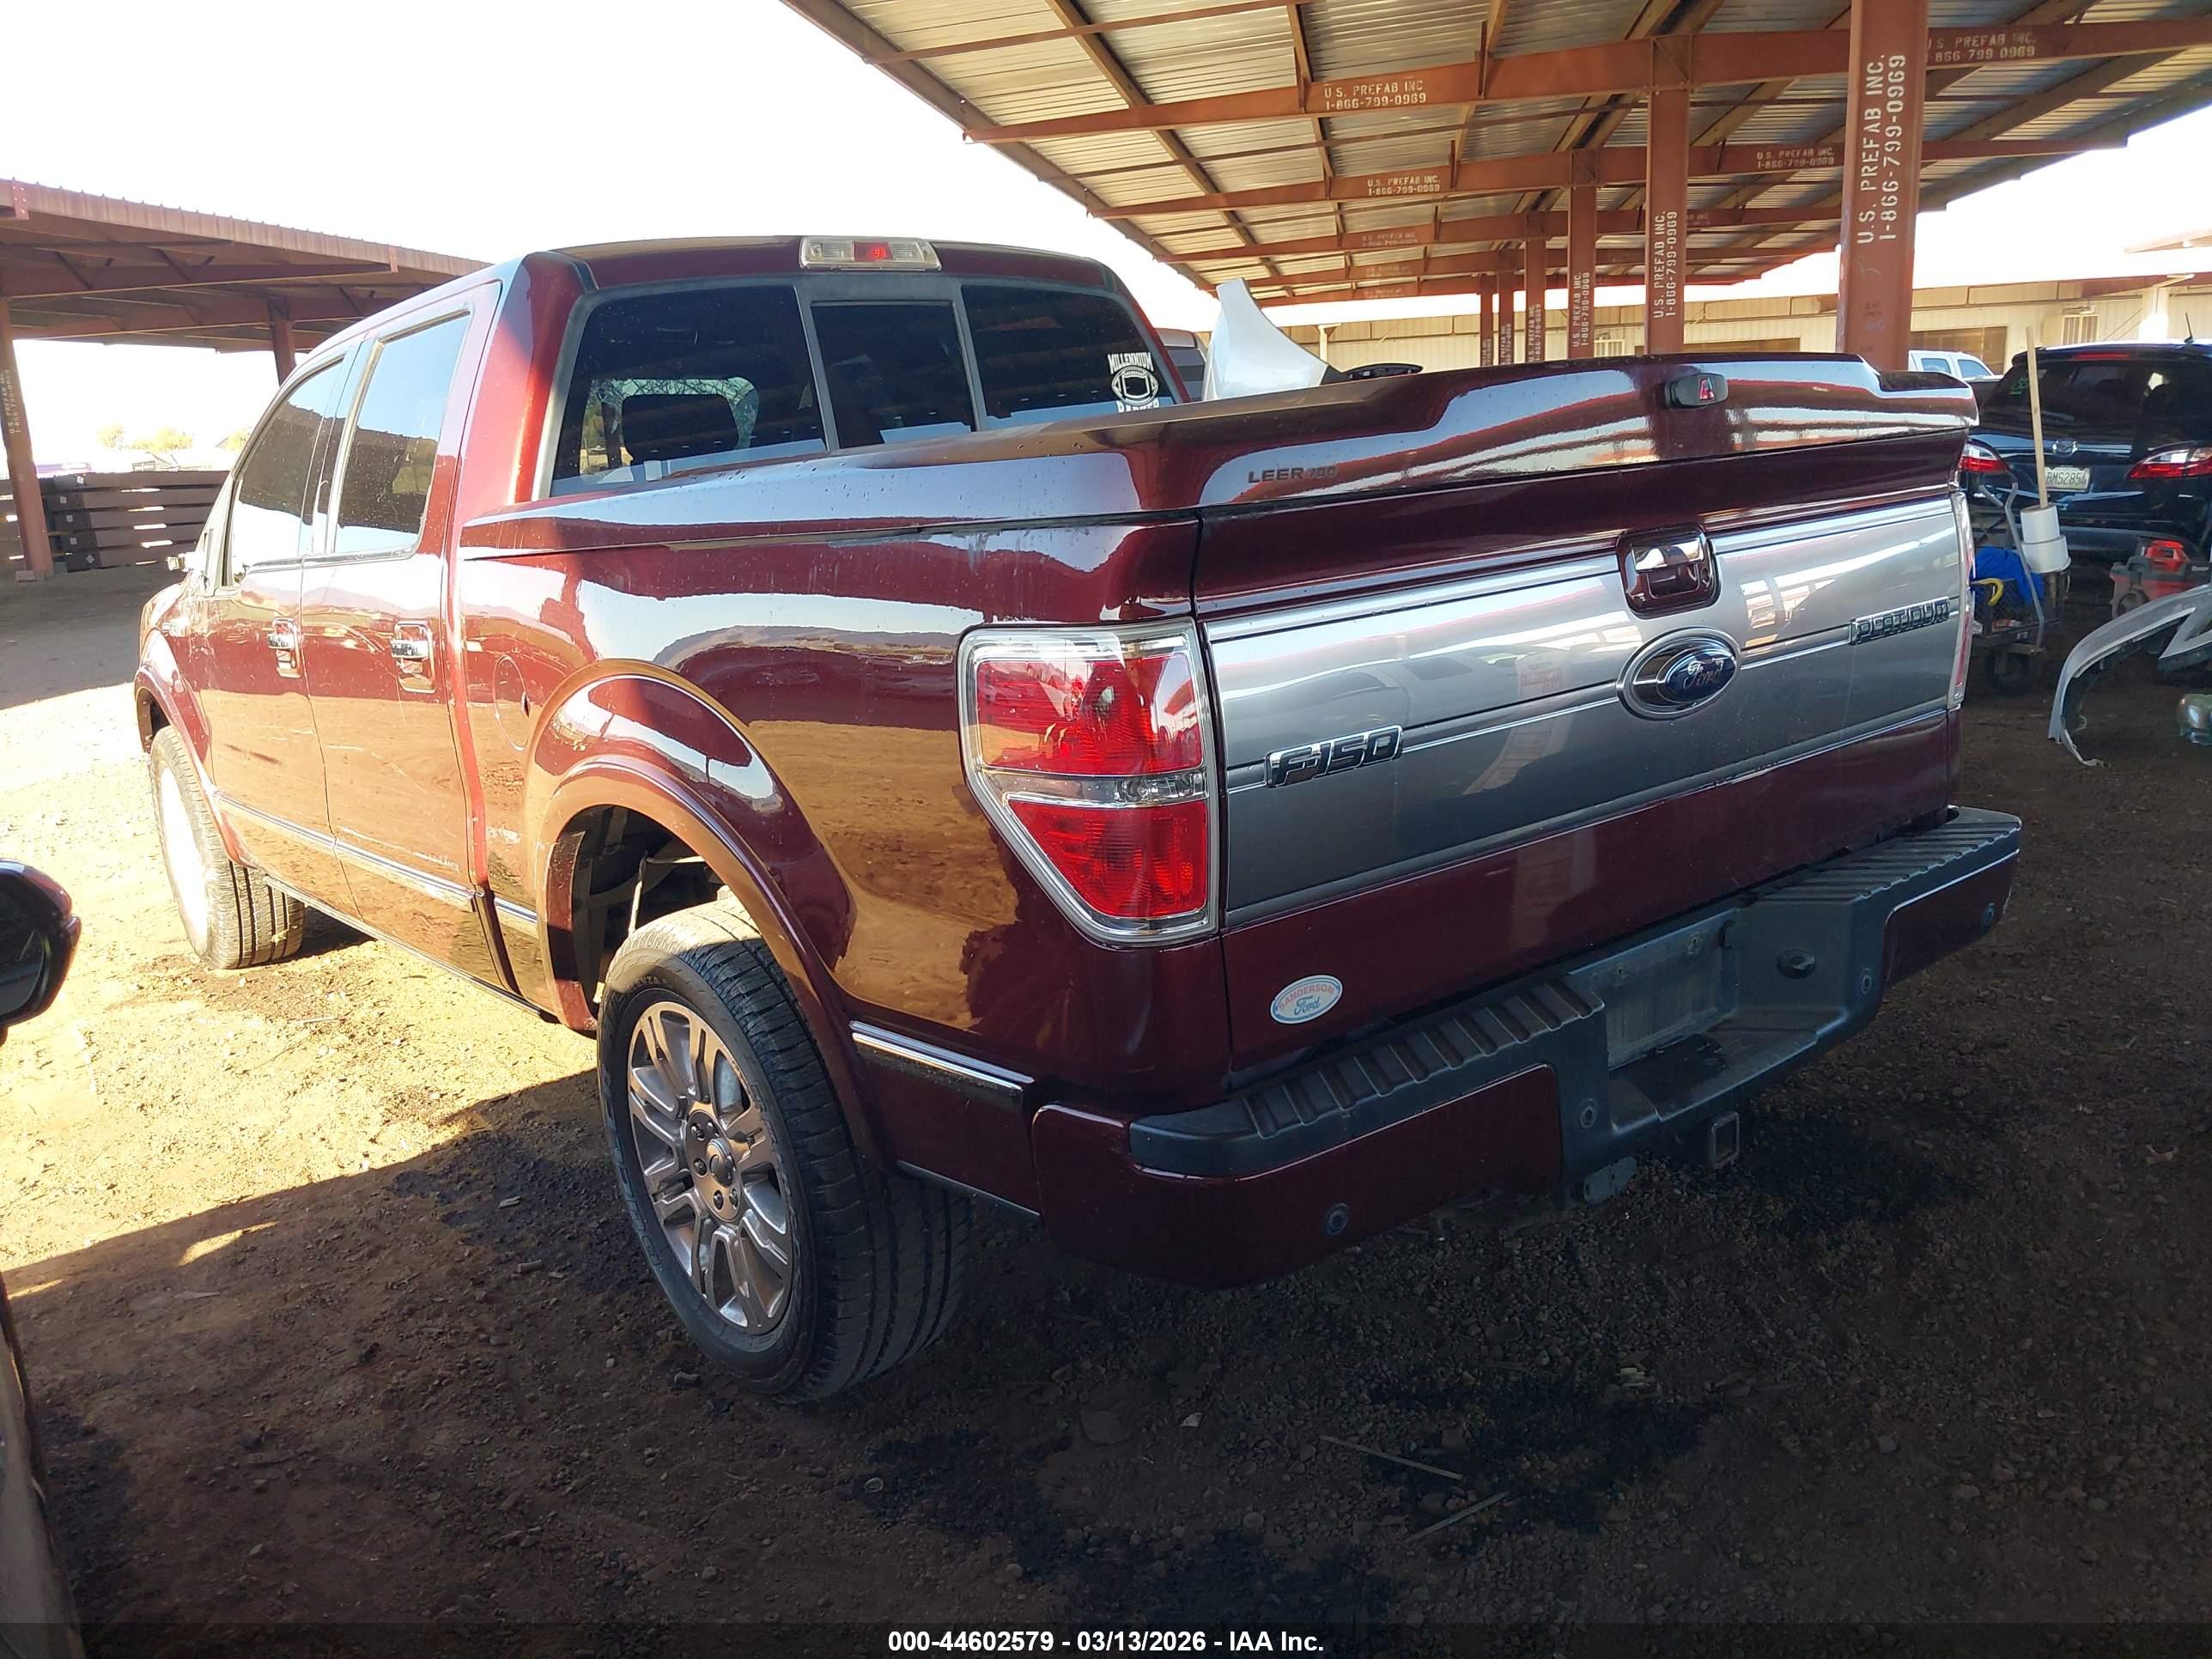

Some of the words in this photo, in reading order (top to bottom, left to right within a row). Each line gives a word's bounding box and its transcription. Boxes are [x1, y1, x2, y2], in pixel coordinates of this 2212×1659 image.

[1955, 33, 2005, 48] PREFAB
[1865, 55, 1885, 95] INC.
[1352, 82, 1399, 96] PREFAB
[1325, 93, 1426, 111] 1-866-799-0969
[1860, 107, 1881, 191] PREFAB
[1879, 55, 1906, 240] 1-866-799-0969
[1388, 176, 1420, 185] PREFAB
[1655, 211, 1666, 235] INC.
[1857, 204, 1877, 244] U.S.
[1654, 241, 1665, 289] PREFAB
[1665, 211, 1678, 316] 1-866-799-0969
[1572, 293, 1581, 326] PREFAB
[1653, 295, 1665, 319] U.S.
[1107, 351, 1154, 374] MILLENNIUM
[1248, 467, 1304, 483] LEER
[2046, 471, 2087, 486] BMS2854
[1850, 597, 1950, 645] PLATINUM
[1277, 983, 1334, 1012] SANDERSON
[1293, 995, 1321, 1016] Ford
